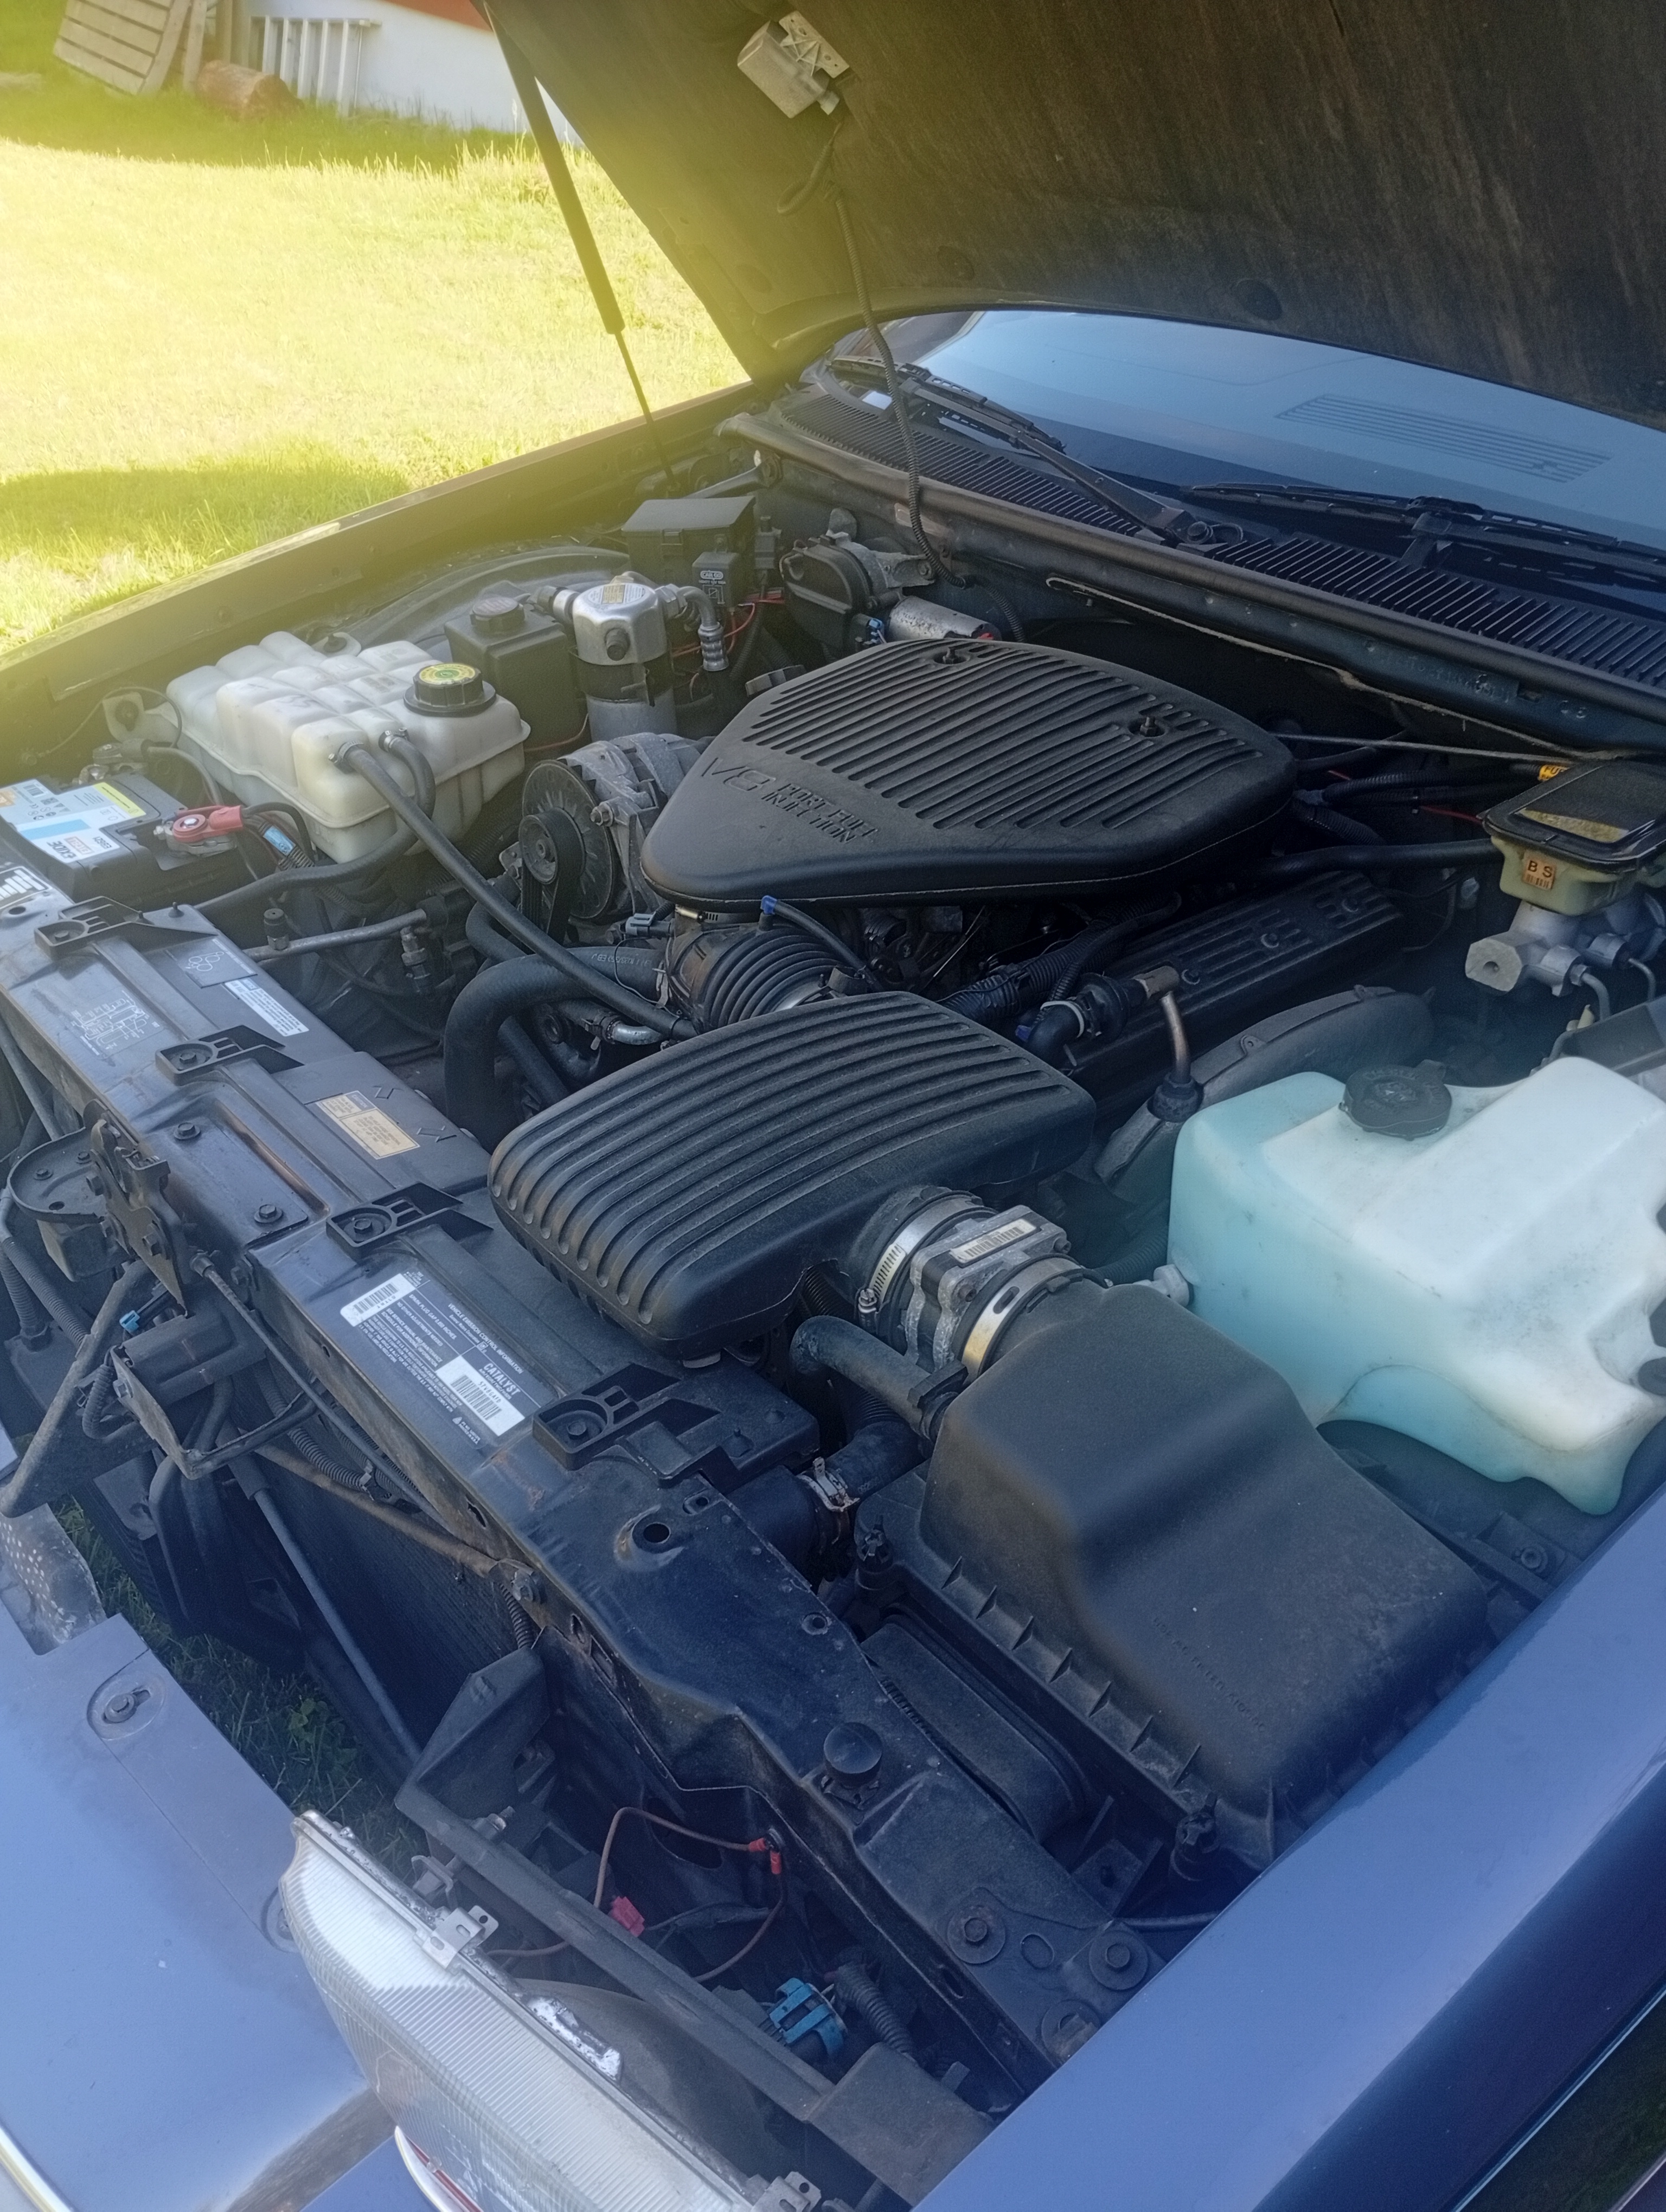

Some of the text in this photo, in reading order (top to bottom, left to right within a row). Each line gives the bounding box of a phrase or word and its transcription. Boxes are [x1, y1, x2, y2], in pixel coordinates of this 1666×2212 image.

[701, 757, 776, 792] V8
[777, 782, 836, 810] PORT
[761, 791, 858, 844] INJECTION
[46, 840, 77, 859] EXIDE
[447, 1302, 524, 1375] VEHICLE EMISSION CONTROL INFORMATION
[482, 1361, 521, 1398] CATALYST
